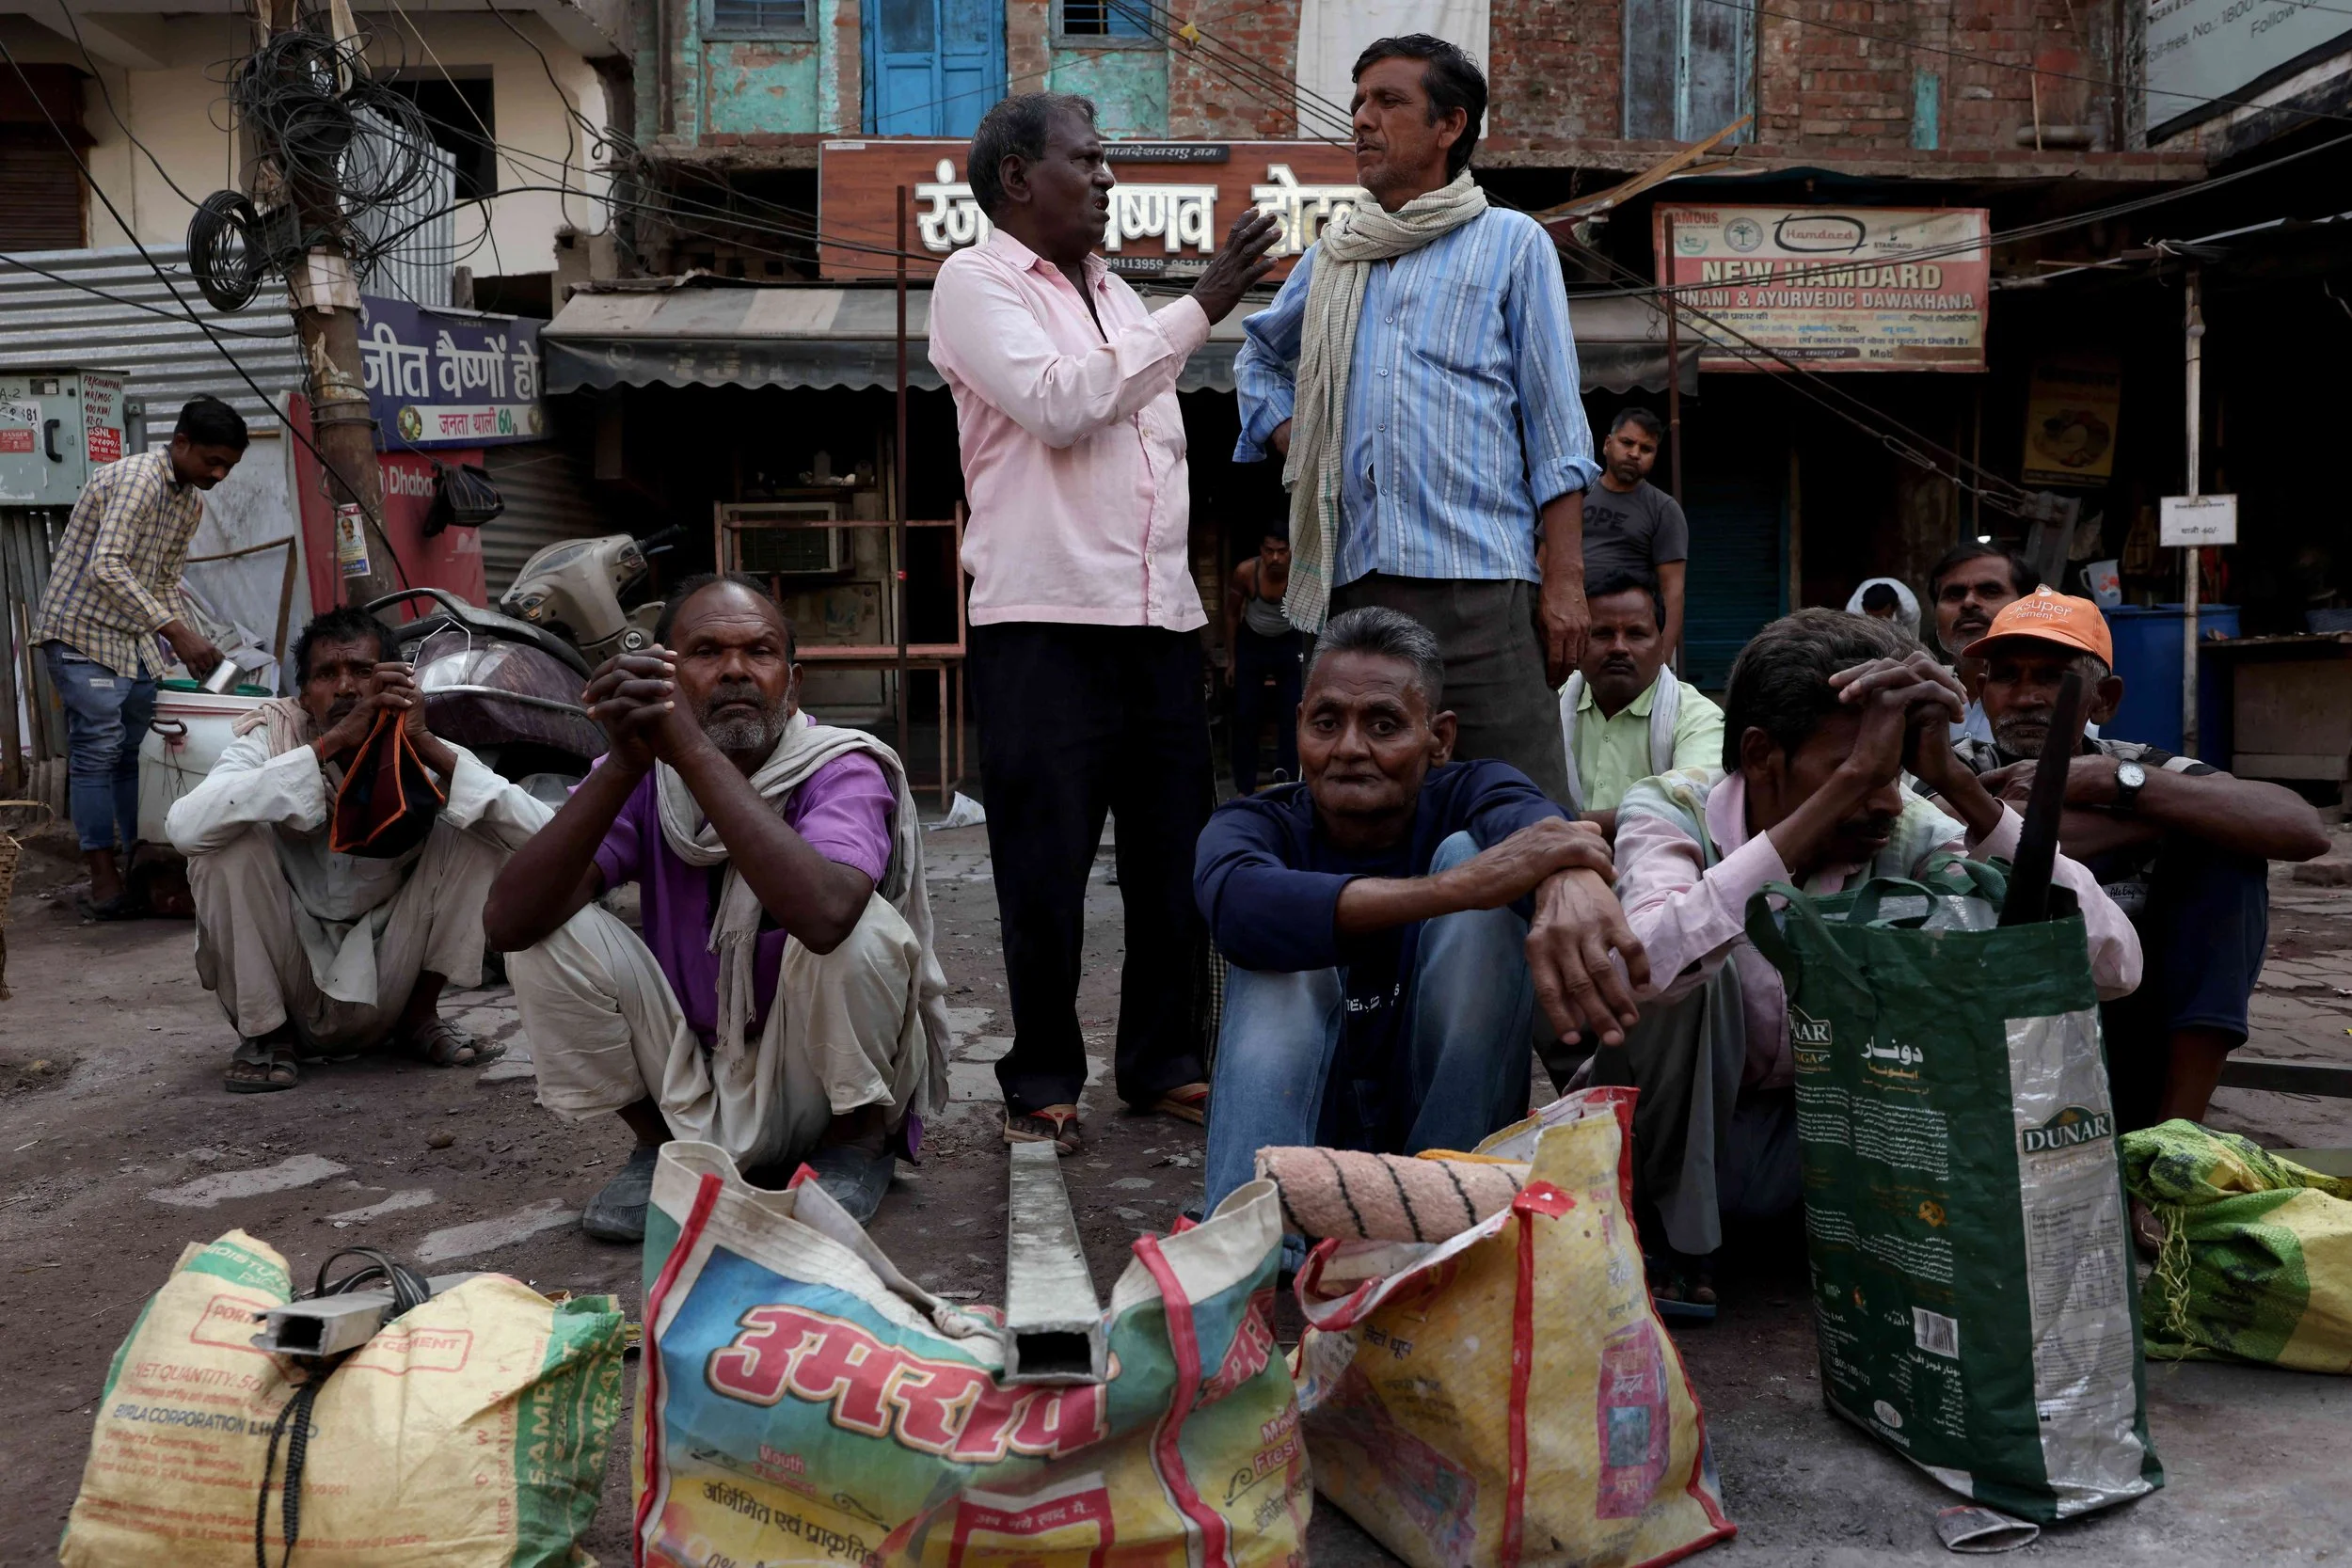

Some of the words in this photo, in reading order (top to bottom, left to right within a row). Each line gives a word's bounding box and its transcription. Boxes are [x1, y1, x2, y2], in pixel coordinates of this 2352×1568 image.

[2250, 3, 2296, 39] Follow
[1673, 212, 1719, 224] AMOUS
[1786, 229, 1854, 240] Hamdard
[1701, 261, 1775, 287] NEW
[1785, 261, 1943, 291] HAMDARD
[1737, 291, 1750, 308] &
[1756, 291, 1856, 309] AYURVEDIC
[1862, 292, 1975, 309] DAWAKHANA
[88, 427, 111, 438] BSNL
[438, 414, 469, 436] जनता
[473, 406, 497, 435] थाली
[389, 466, 435, 498] Dhaba
[1582, 504, 1629, 532] OPE
[2016, 610, 2053, 621] cement
[1859, 1035, 1924, 1066] دونار
[2025, 1116, 2109, 1152] DUNAR
[382, 1337, 462, 1353] CEMENT
[113, 1403, 148, 1422] BIRLA
[148, 1406, 245, 1433] CORPORATION
[759, 1445, 806, 1476] Mouth
